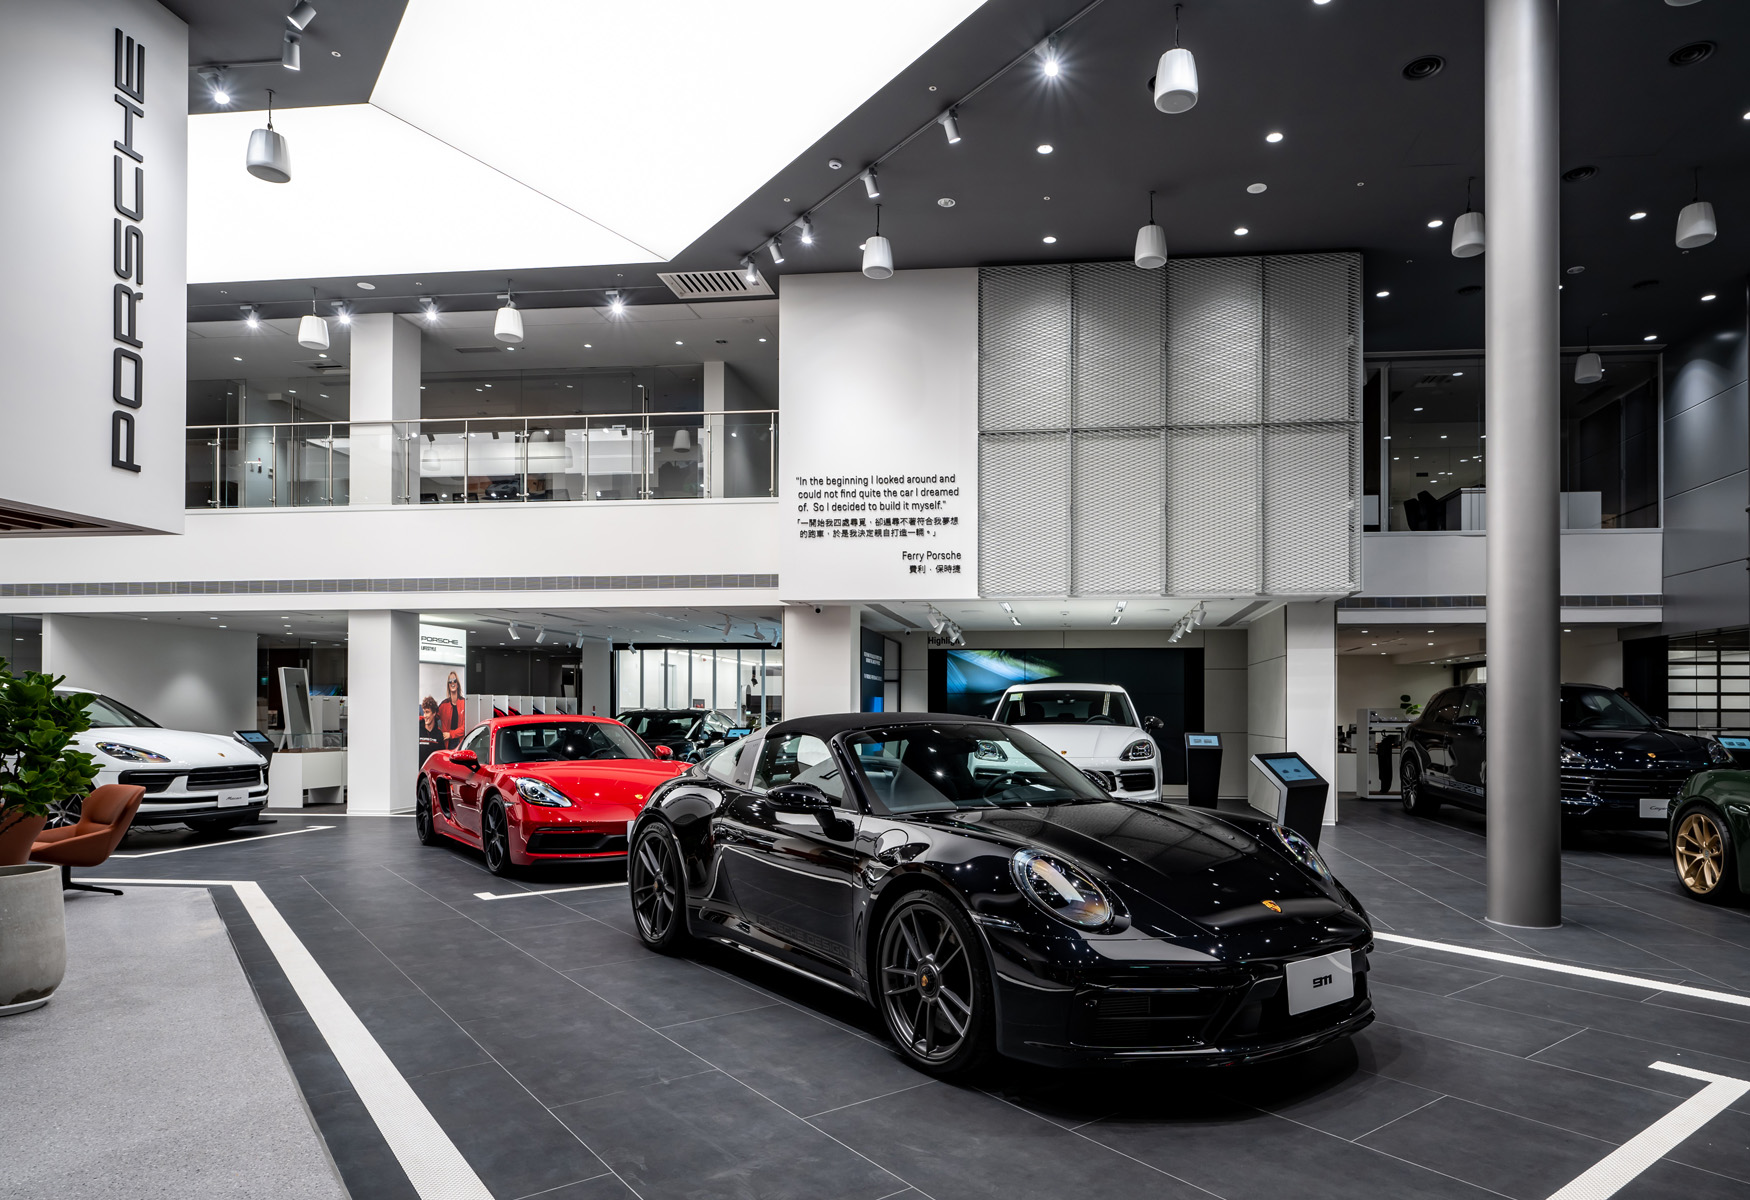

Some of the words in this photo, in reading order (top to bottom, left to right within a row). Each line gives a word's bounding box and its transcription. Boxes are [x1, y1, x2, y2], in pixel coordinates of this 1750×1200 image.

[111, 27, 145, 473] PORSCHE
[809, 476, 824, 486] the
[826, 476, 868, 487] beginning
[876, 475, 905, 485] looked
[907, 474, 937, 484] around
[939, 473, 956, 483] and
[798, 489, 822, 499] could
[824, 490, 839, 499] not
[840, 489, 857, 498] find
[859, 488, 881, 499] quite
[883, 488, 898, 498] the
[900, 489, 914, 497] car
[920, 486, 960, 497] dreamed
[797, 502, 809, 512] of.
[813, 502, 825, 512] So
[831, 501, 866, 511] decided
[868, 502, 877, 511] to
[879, 501, 901, 511] build
[903, 500, 909, 510] it
[902, 551, 924, 562] Ferry
[926, 550, 962, 561] Porsche
[421, 635, 459, 645] PORSCHE
[807, 934, 849, 957] DESIGN
[1313, 974, 1333, 989] 911
